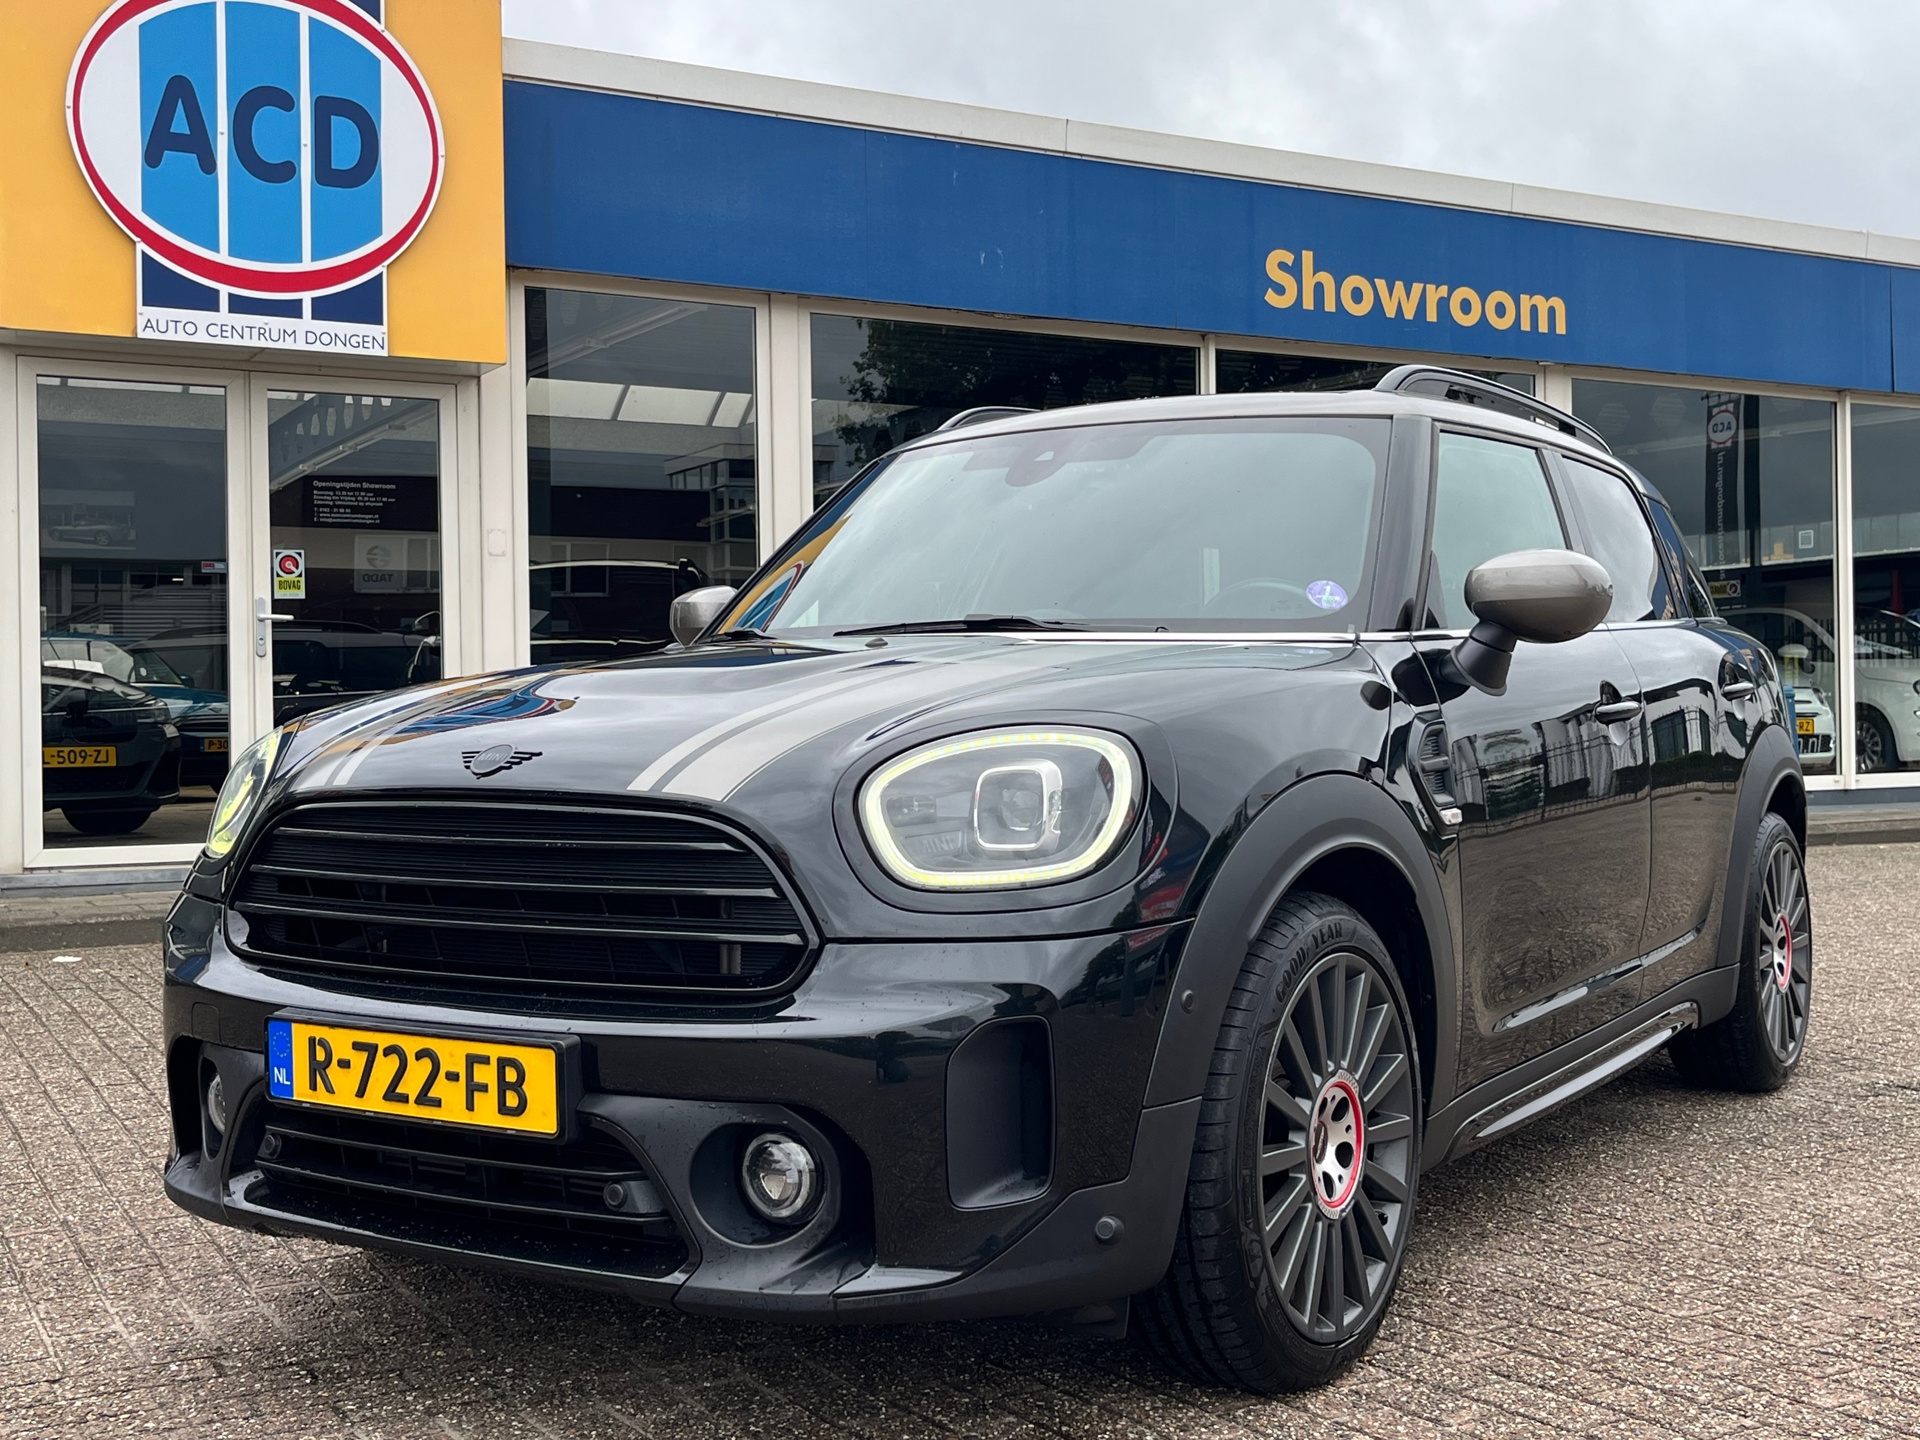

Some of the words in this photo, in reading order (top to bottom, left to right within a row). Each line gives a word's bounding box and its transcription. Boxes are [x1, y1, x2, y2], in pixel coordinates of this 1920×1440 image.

[144, 74, 379, 189] ACD
[1264, 249, 1567, 335] Showroom
[142, 317, 198, 337] AUTO
[205, 321, 297, 345] CENTRUM
[305, 329, 385, 351] DONGEN
[313, 480, 361, 490] Openingstijden
[362, 482, 396, 490] Showroom
[278, 579, 301, 591] BOVAG
[477, 751, 507, 762] MINI
[274, 1067, 291, 1086] NL
[307, 1035, 529, 1118] R-722-FB
